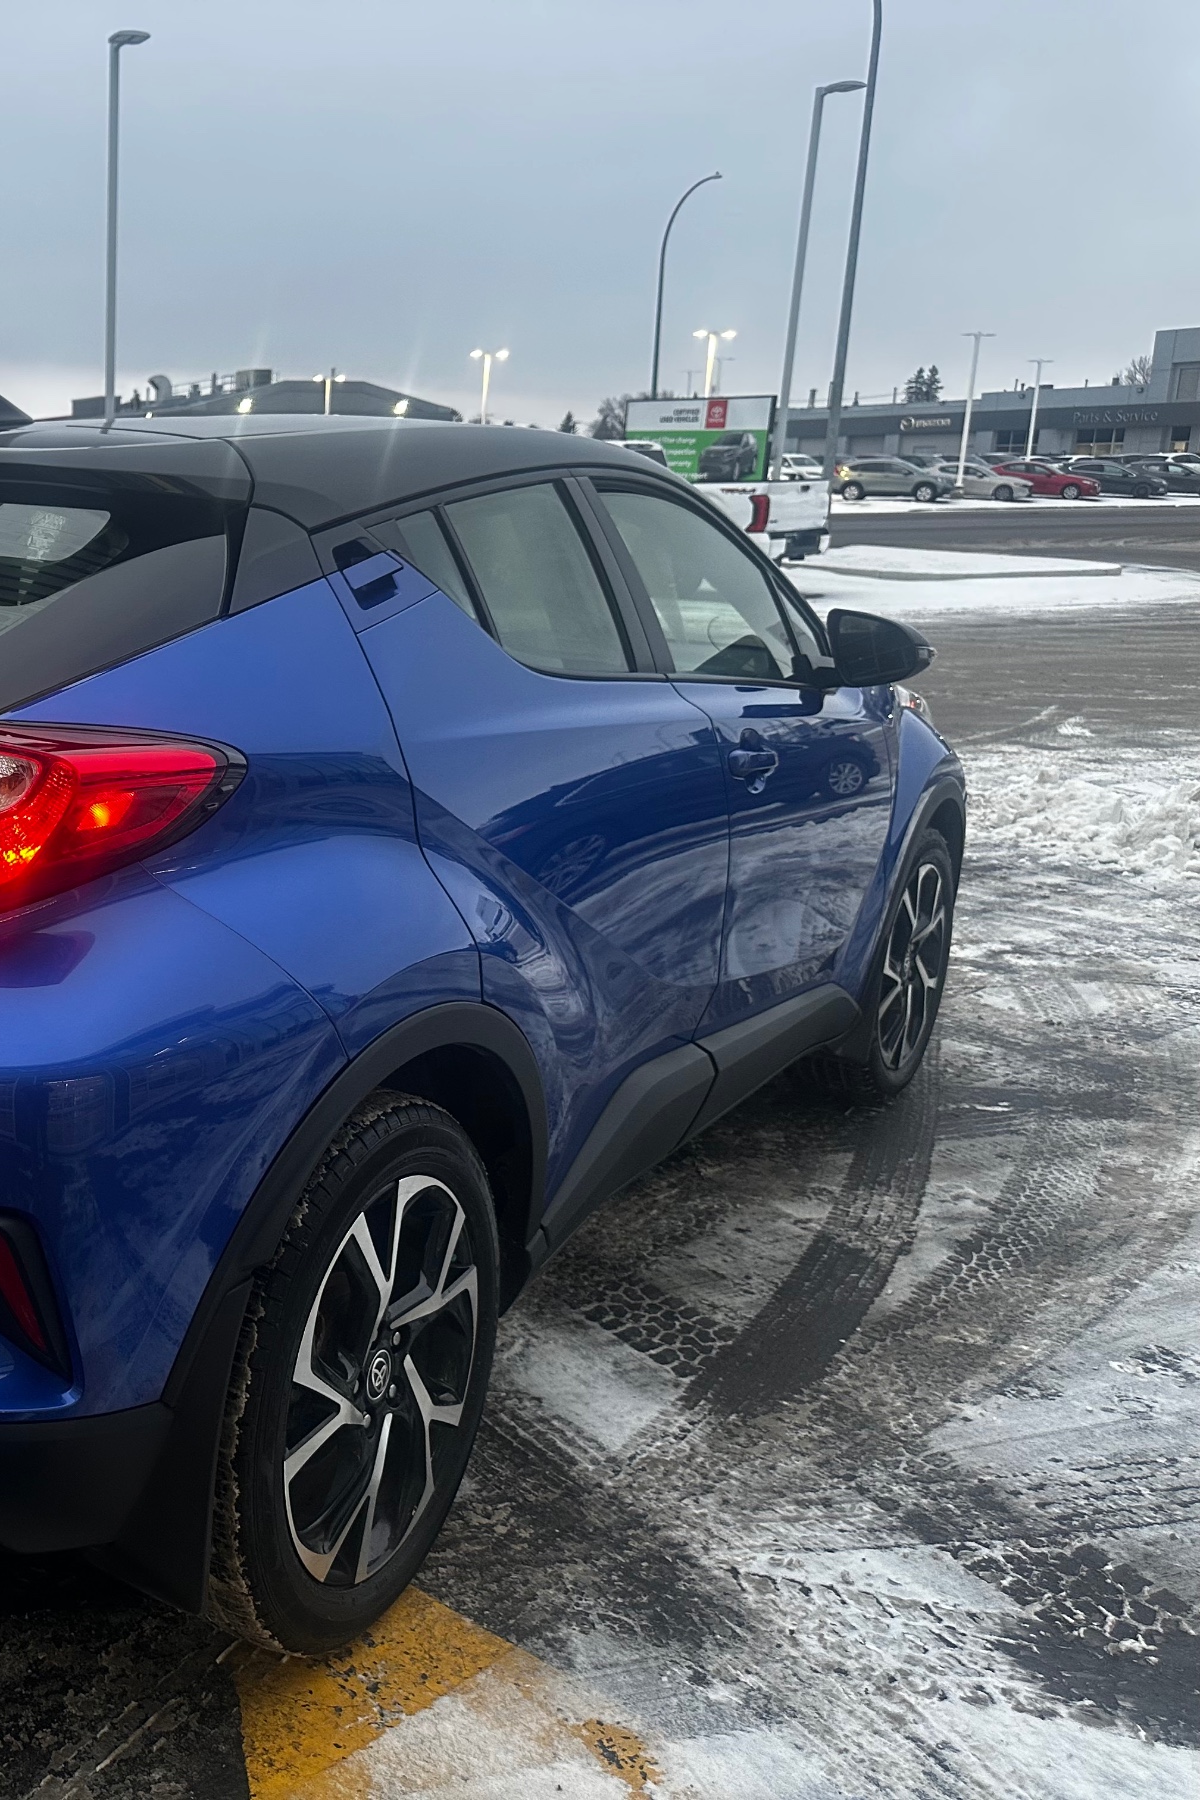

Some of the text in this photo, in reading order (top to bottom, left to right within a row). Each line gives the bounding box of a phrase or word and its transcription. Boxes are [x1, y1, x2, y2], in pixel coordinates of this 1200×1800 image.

[1073, 408, 1158, 423] Parts & Service
